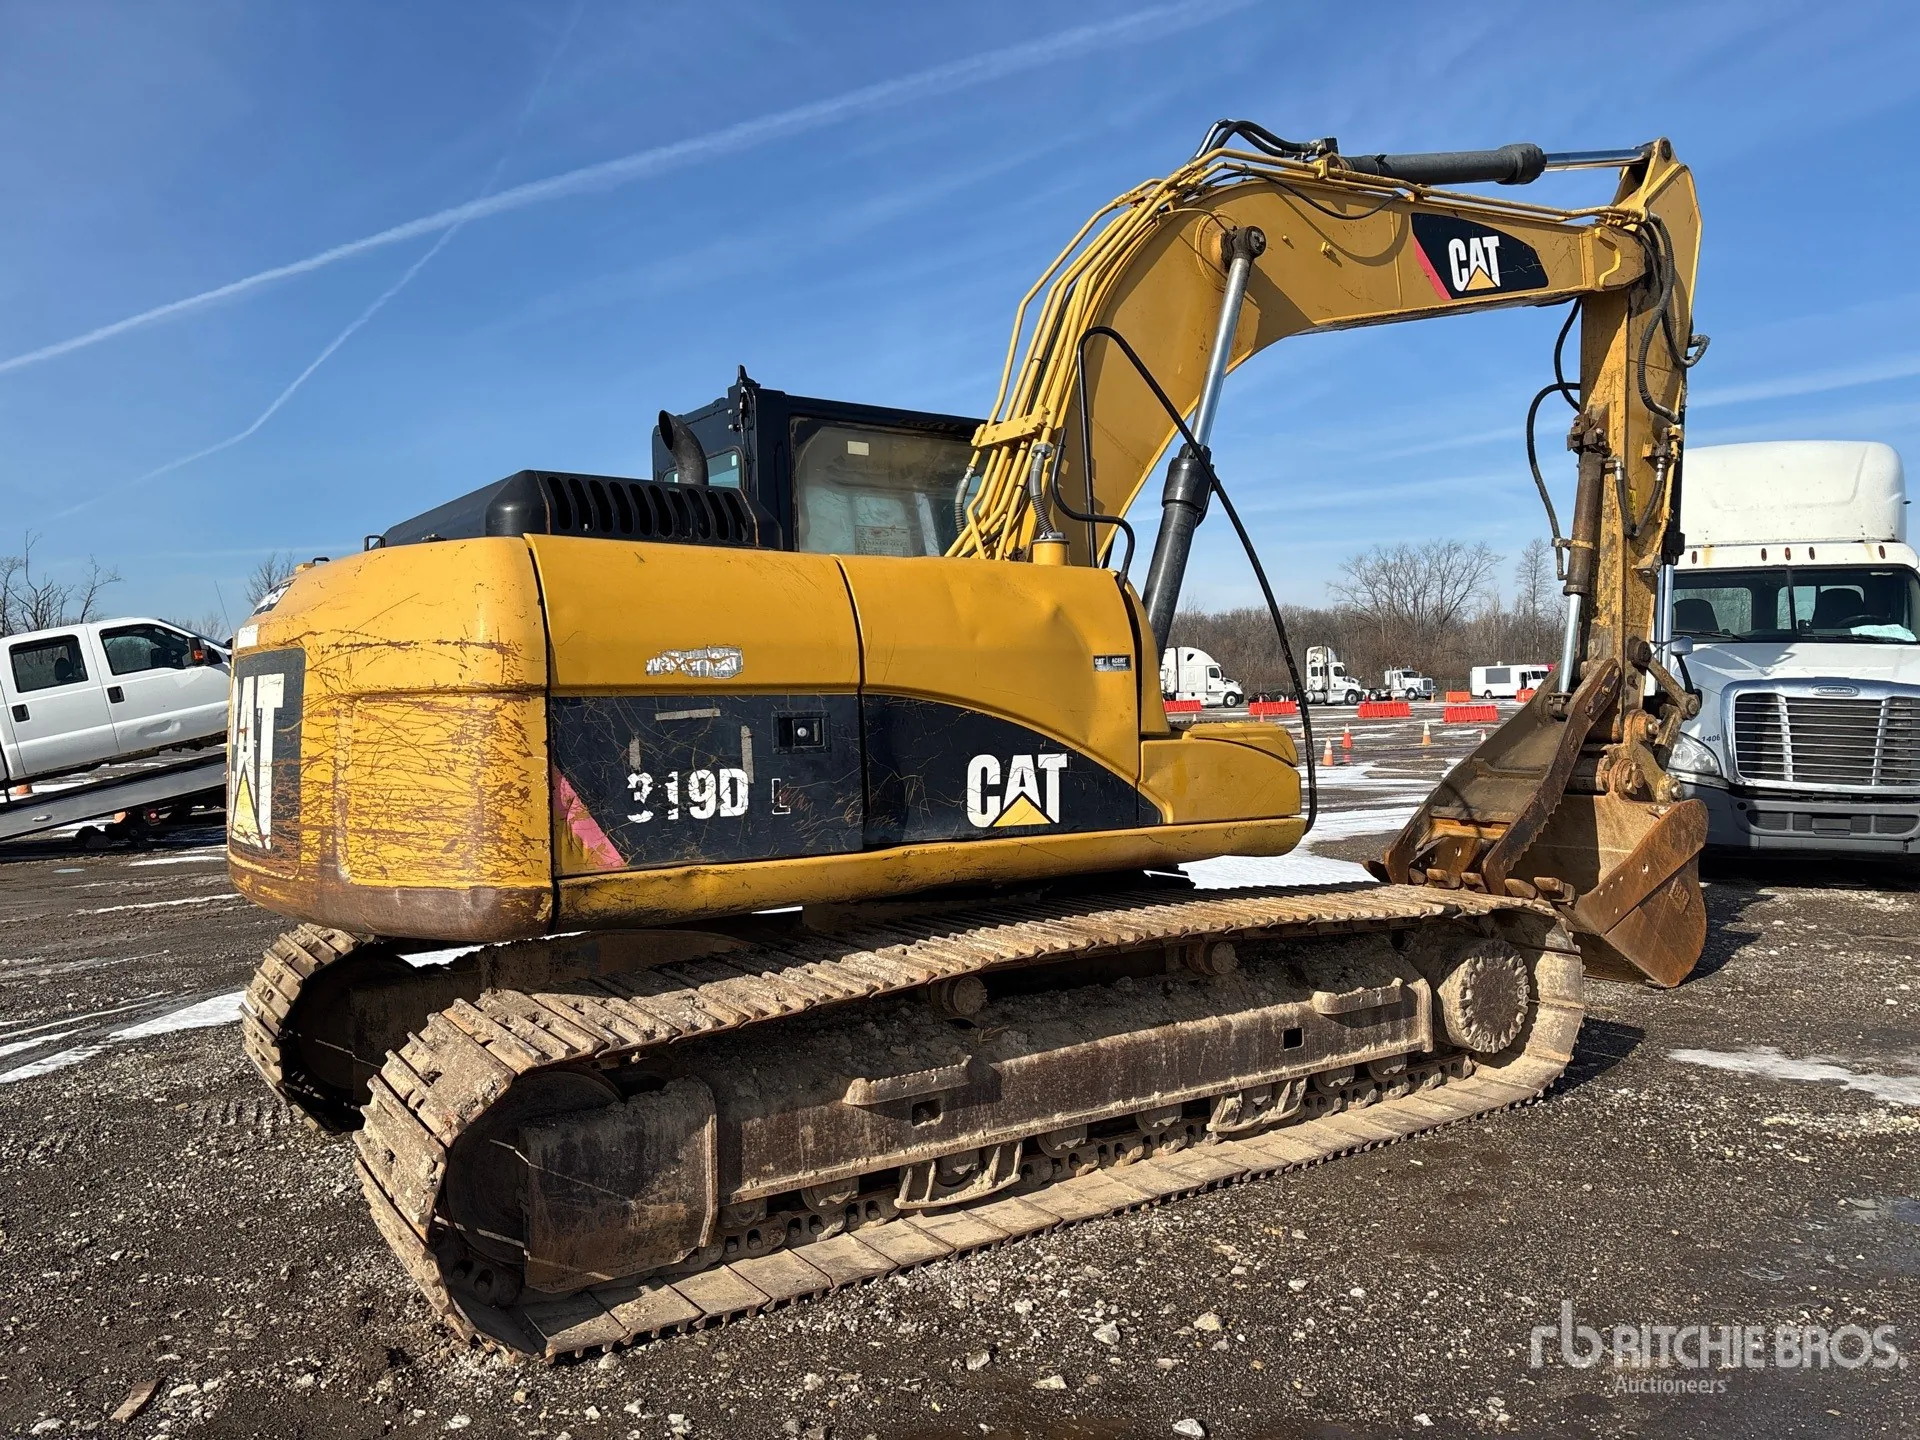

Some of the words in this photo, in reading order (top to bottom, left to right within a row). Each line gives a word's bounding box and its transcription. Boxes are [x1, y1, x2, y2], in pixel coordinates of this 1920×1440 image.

[1448, 235, 1501, 292] CAT
[627, 768, 749, 823] 319D
[967, 753, 1068, 828] CAT
